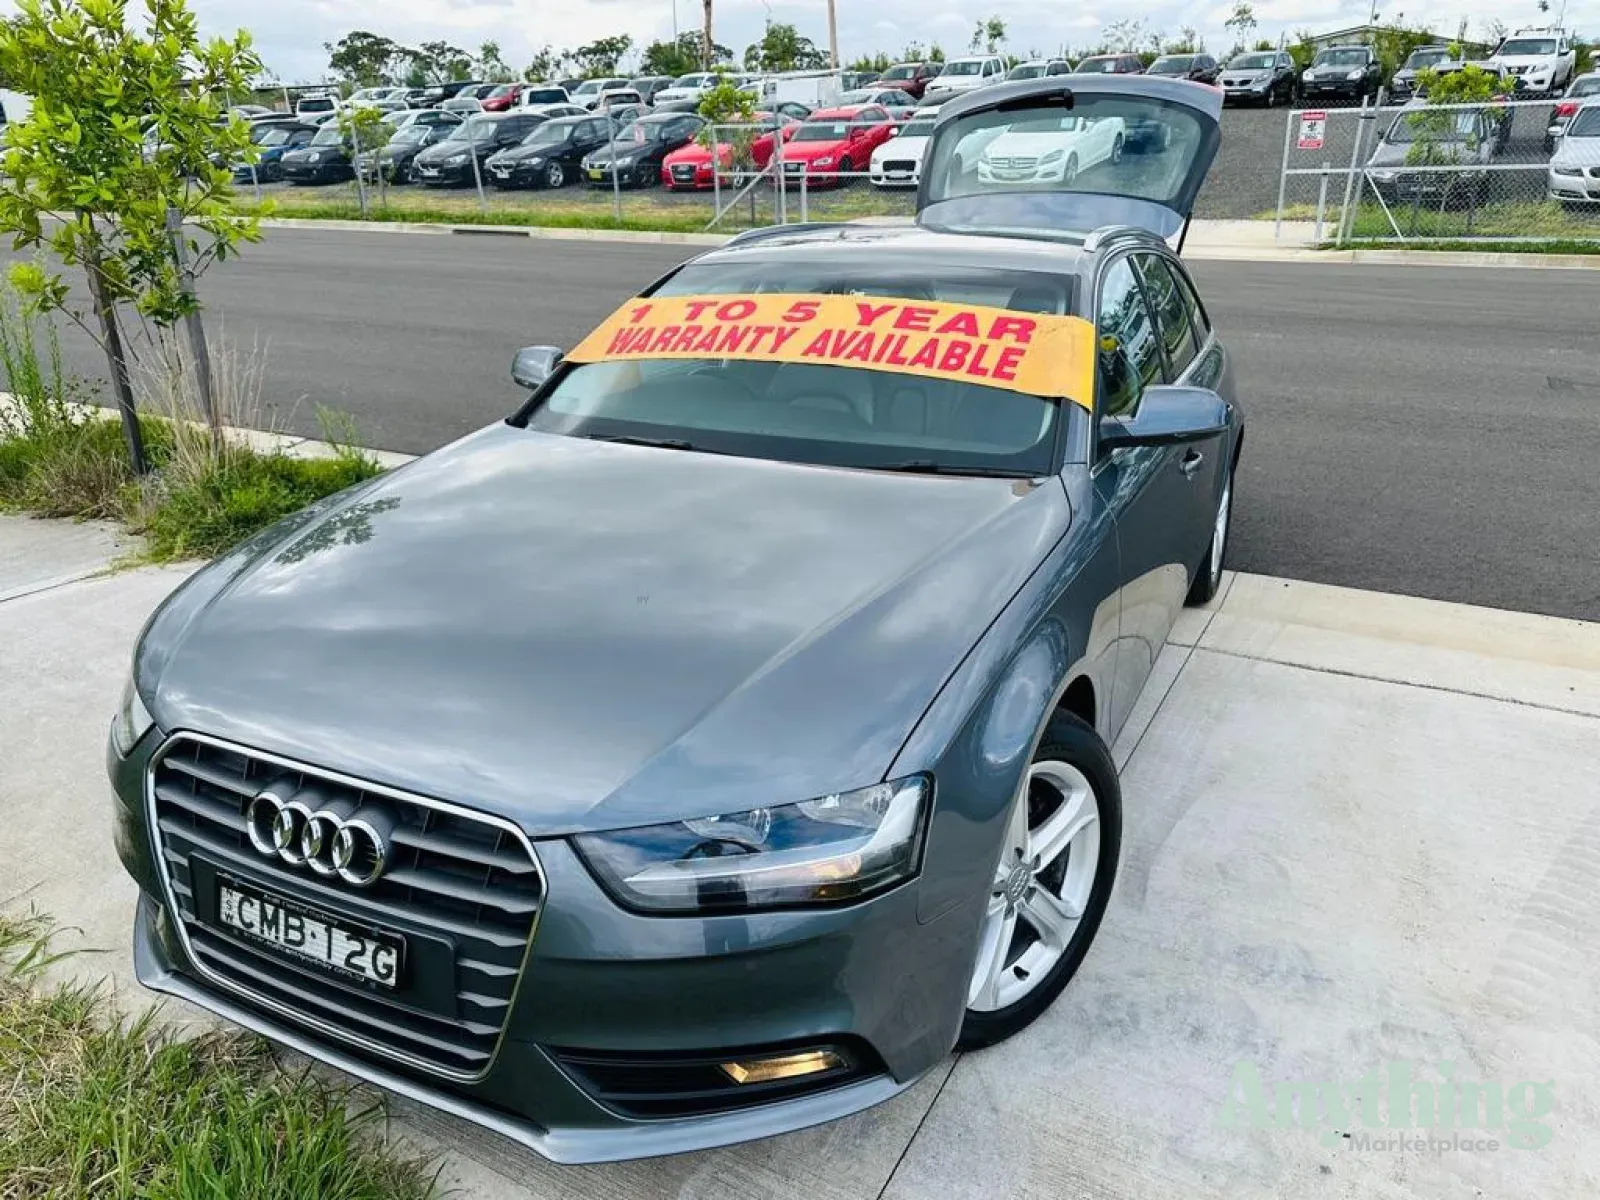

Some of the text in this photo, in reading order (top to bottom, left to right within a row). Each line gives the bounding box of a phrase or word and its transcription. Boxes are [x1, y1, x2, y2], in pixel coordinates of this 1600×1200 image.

[630, 299, 1037, 344] 1 TO 5 YEAR
[605, 325, 1027, 381] WARRANTY AVAILABLE
